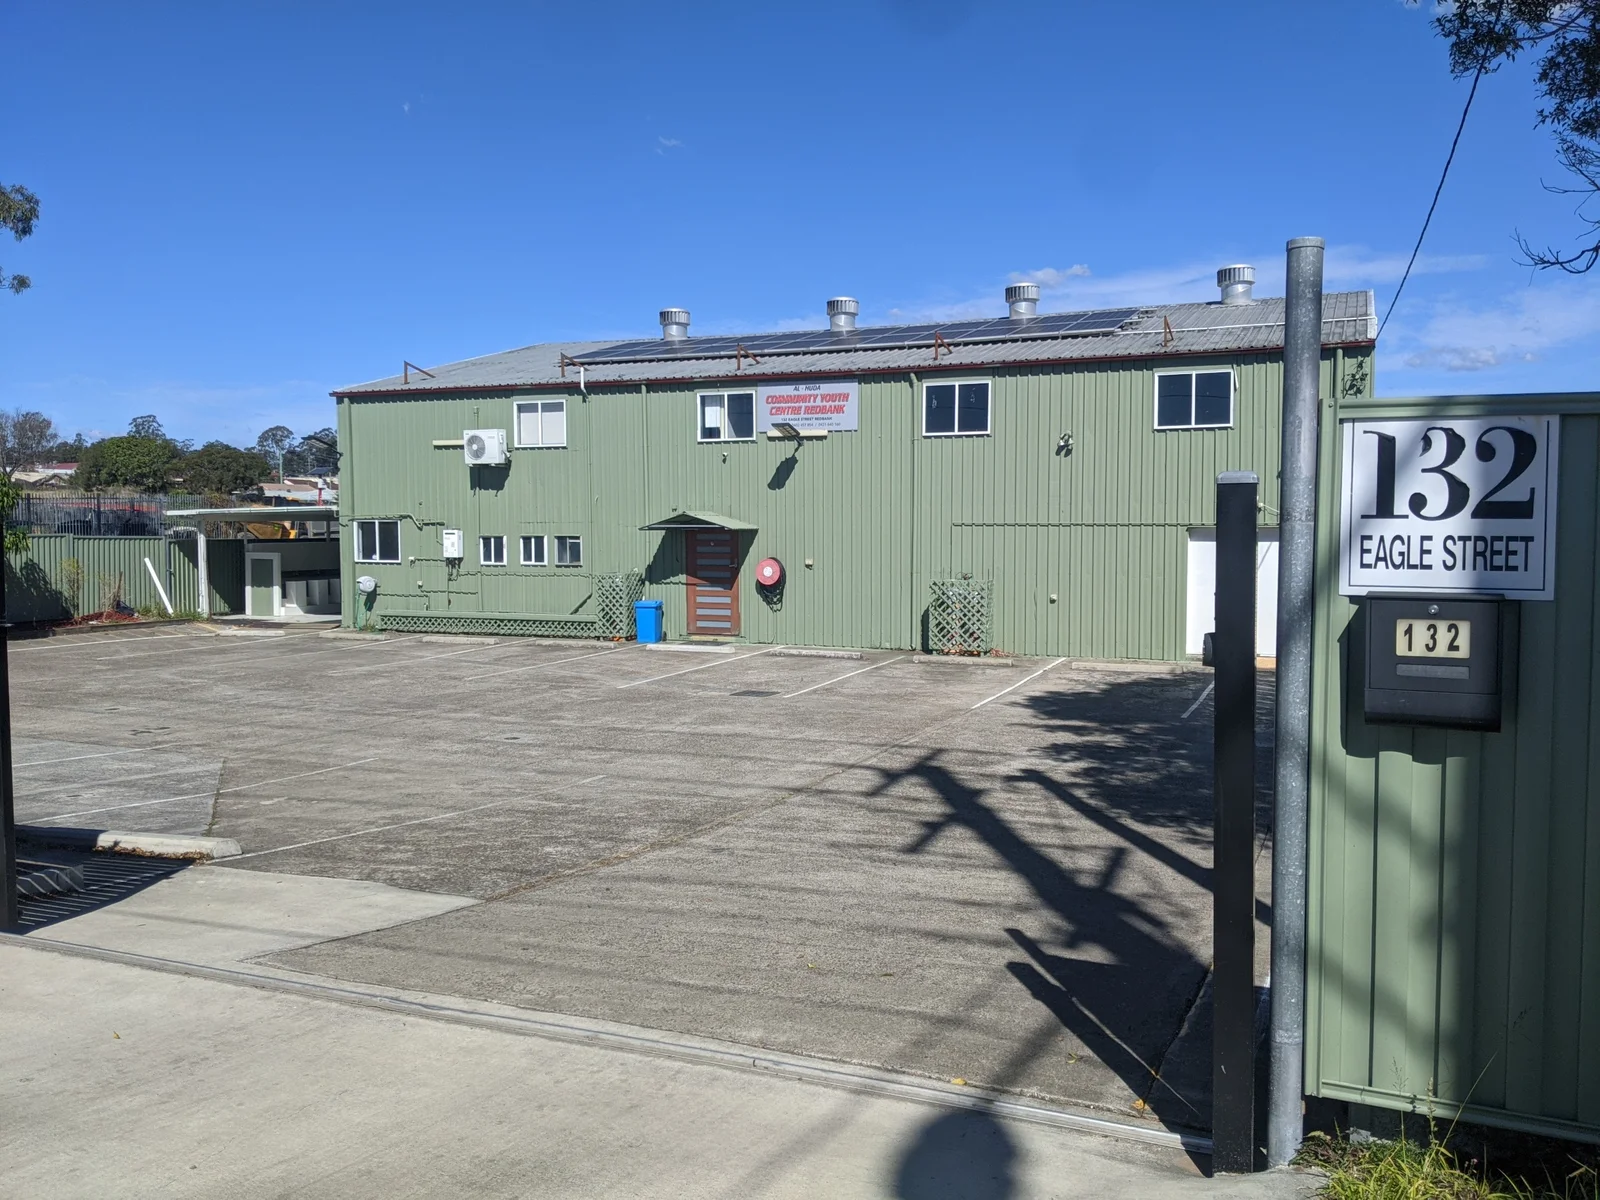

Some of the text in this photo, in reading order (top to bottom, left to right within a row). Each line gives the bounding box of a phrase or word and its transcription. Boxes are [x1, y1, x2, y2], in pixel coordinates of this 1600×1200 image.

[766, 392, 850, 404] COMMUNITY YOUTH
[769, 404, 846, 416] CENTRE REDBANK
[1360, 426, 1538, 522] 132
[1359, 534, 1534, 572] EAGLE STREET
[1403, 623, 1460, 652] 132
